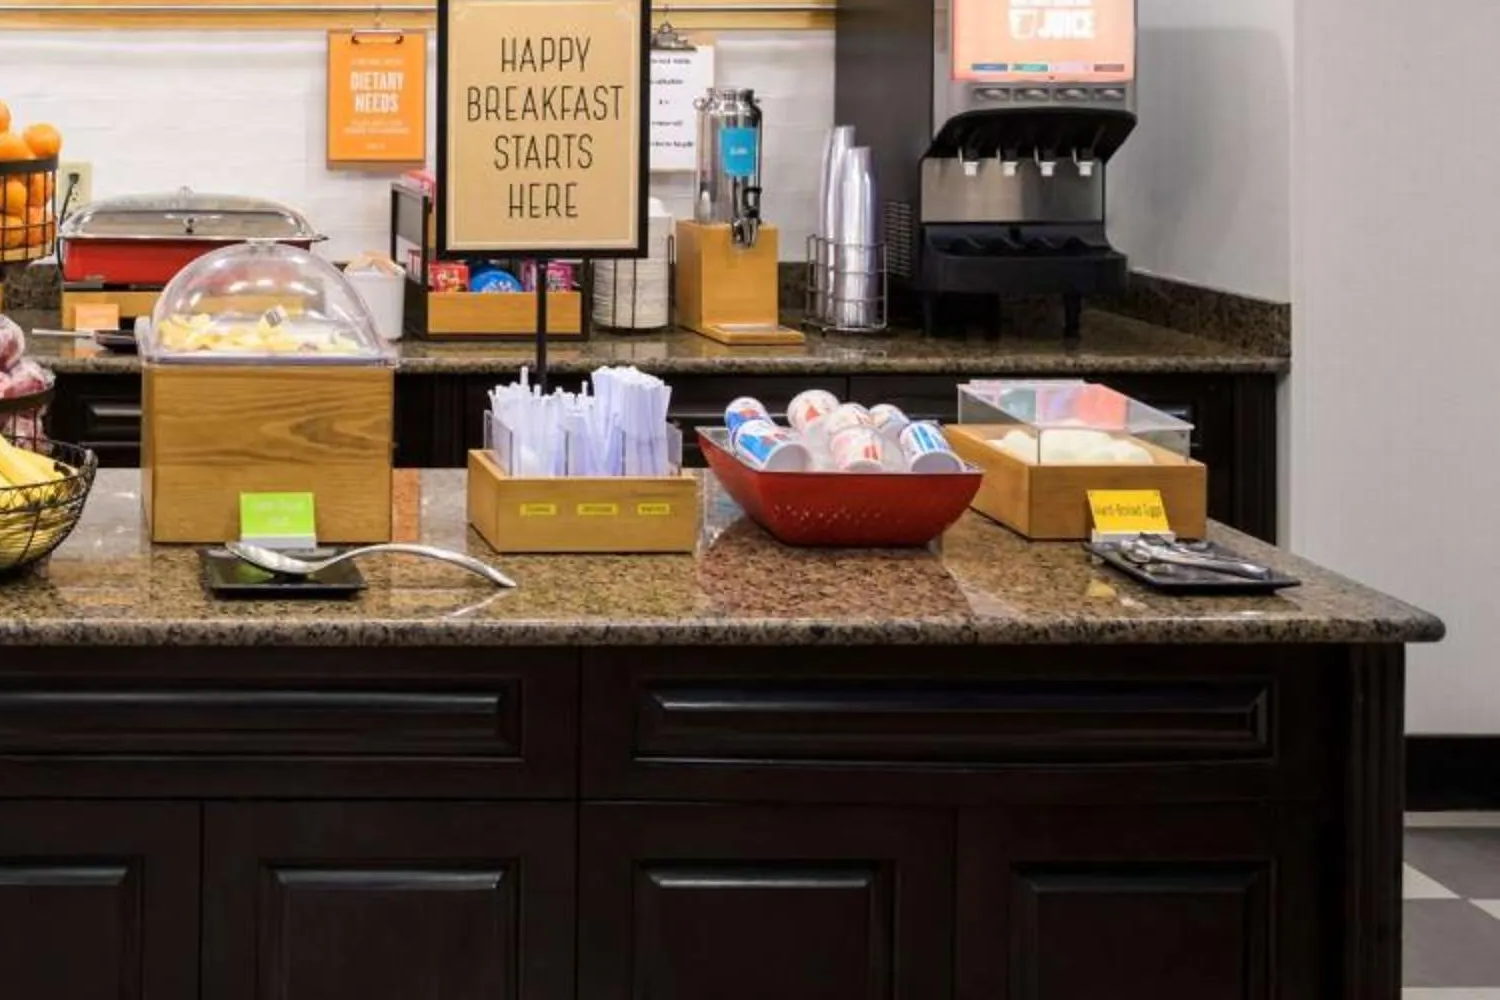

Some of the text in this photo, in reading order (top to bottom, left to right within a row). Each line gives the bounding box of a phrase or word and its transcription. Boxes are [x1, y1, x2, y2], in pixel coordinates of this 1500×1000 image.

[500, 36, 591, 73] HAPPY
[350, 71, 405, 91] DIETARY
[354, 92, 400, 113] NEEDS
[466, 85, 624, 123] BREAKFAST
[492, 133, 594, 171] STARTS
[507, 182, 579, 219] HERE
